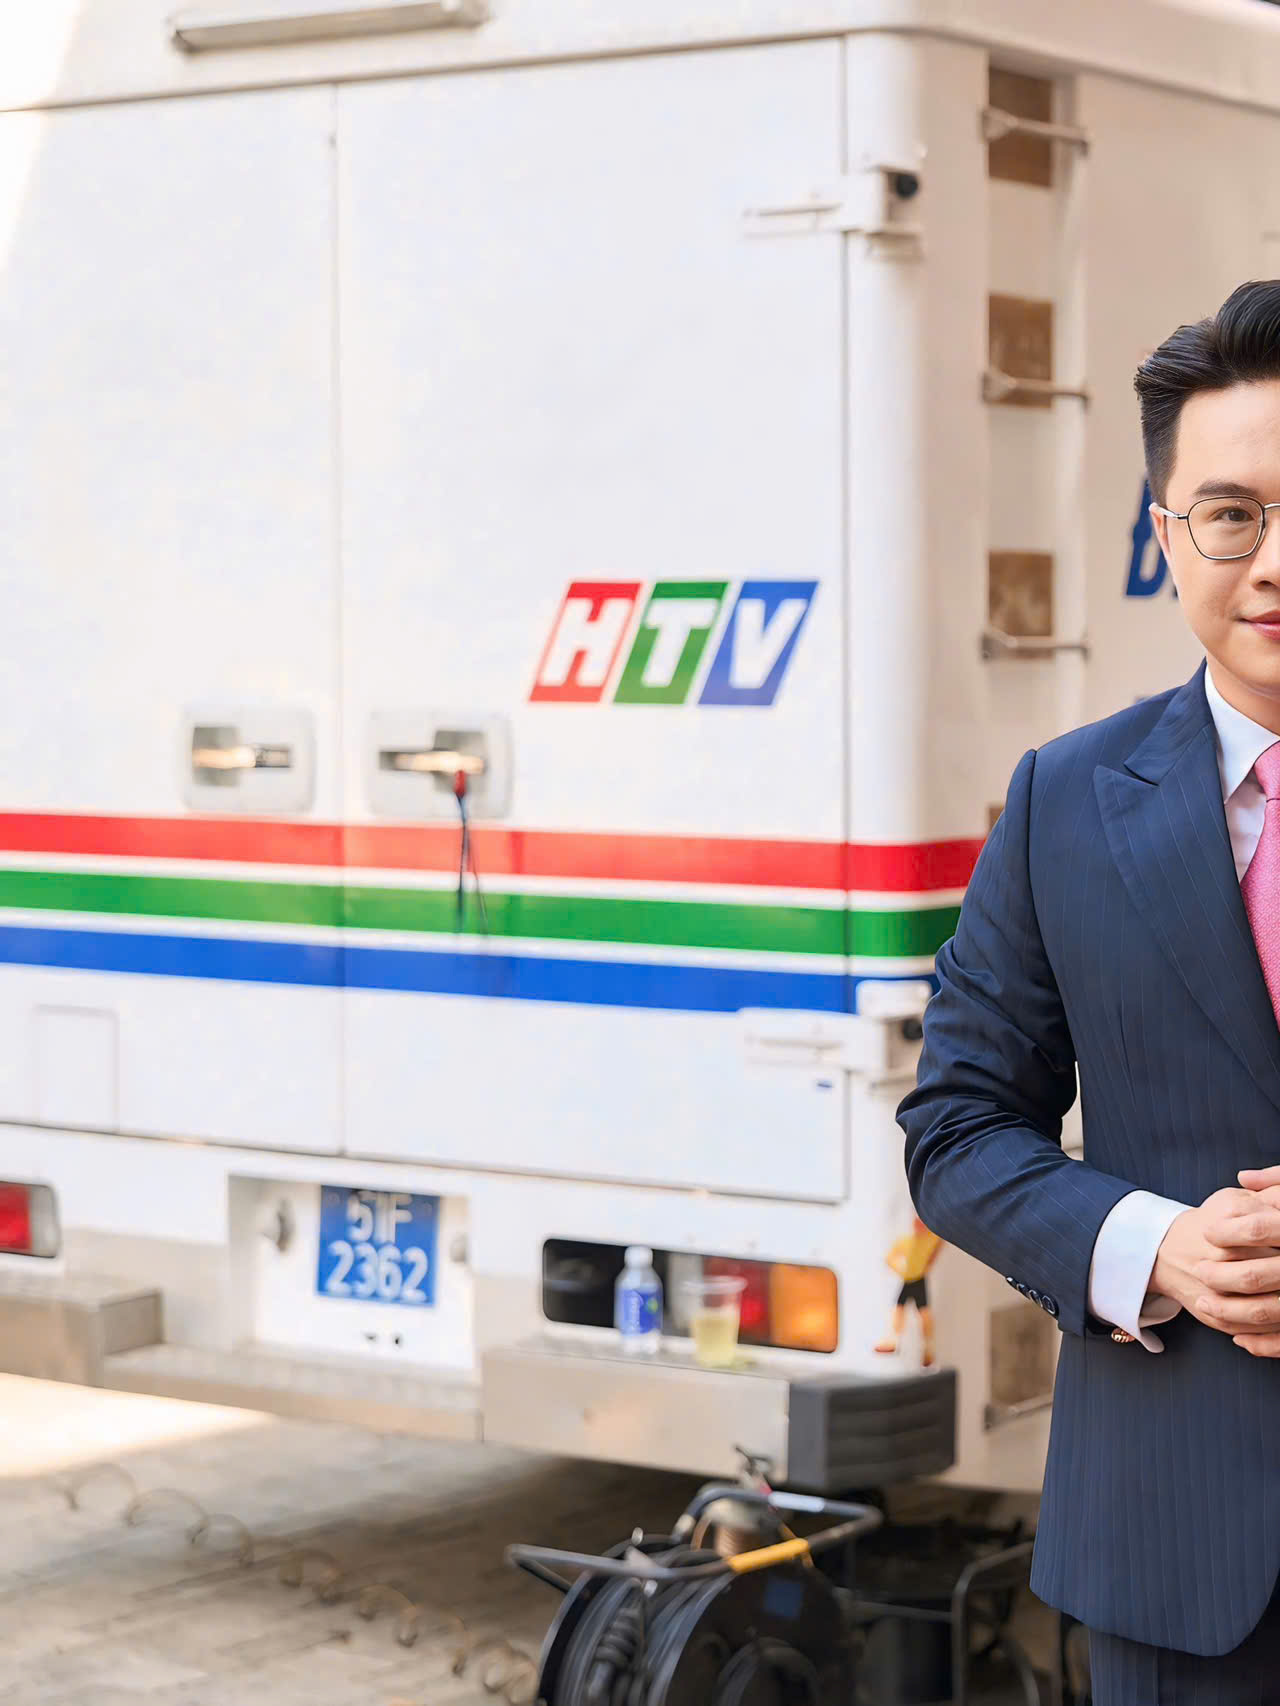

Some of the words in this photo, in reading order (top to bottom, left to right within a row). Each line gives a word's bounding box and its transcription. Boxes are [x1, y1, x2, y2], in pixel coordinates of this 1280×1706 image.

[539, 596, 808, 690] HTV
[346, 1188, 413, 1246] 51F
[325, 1239, 429, 1304] 2362
